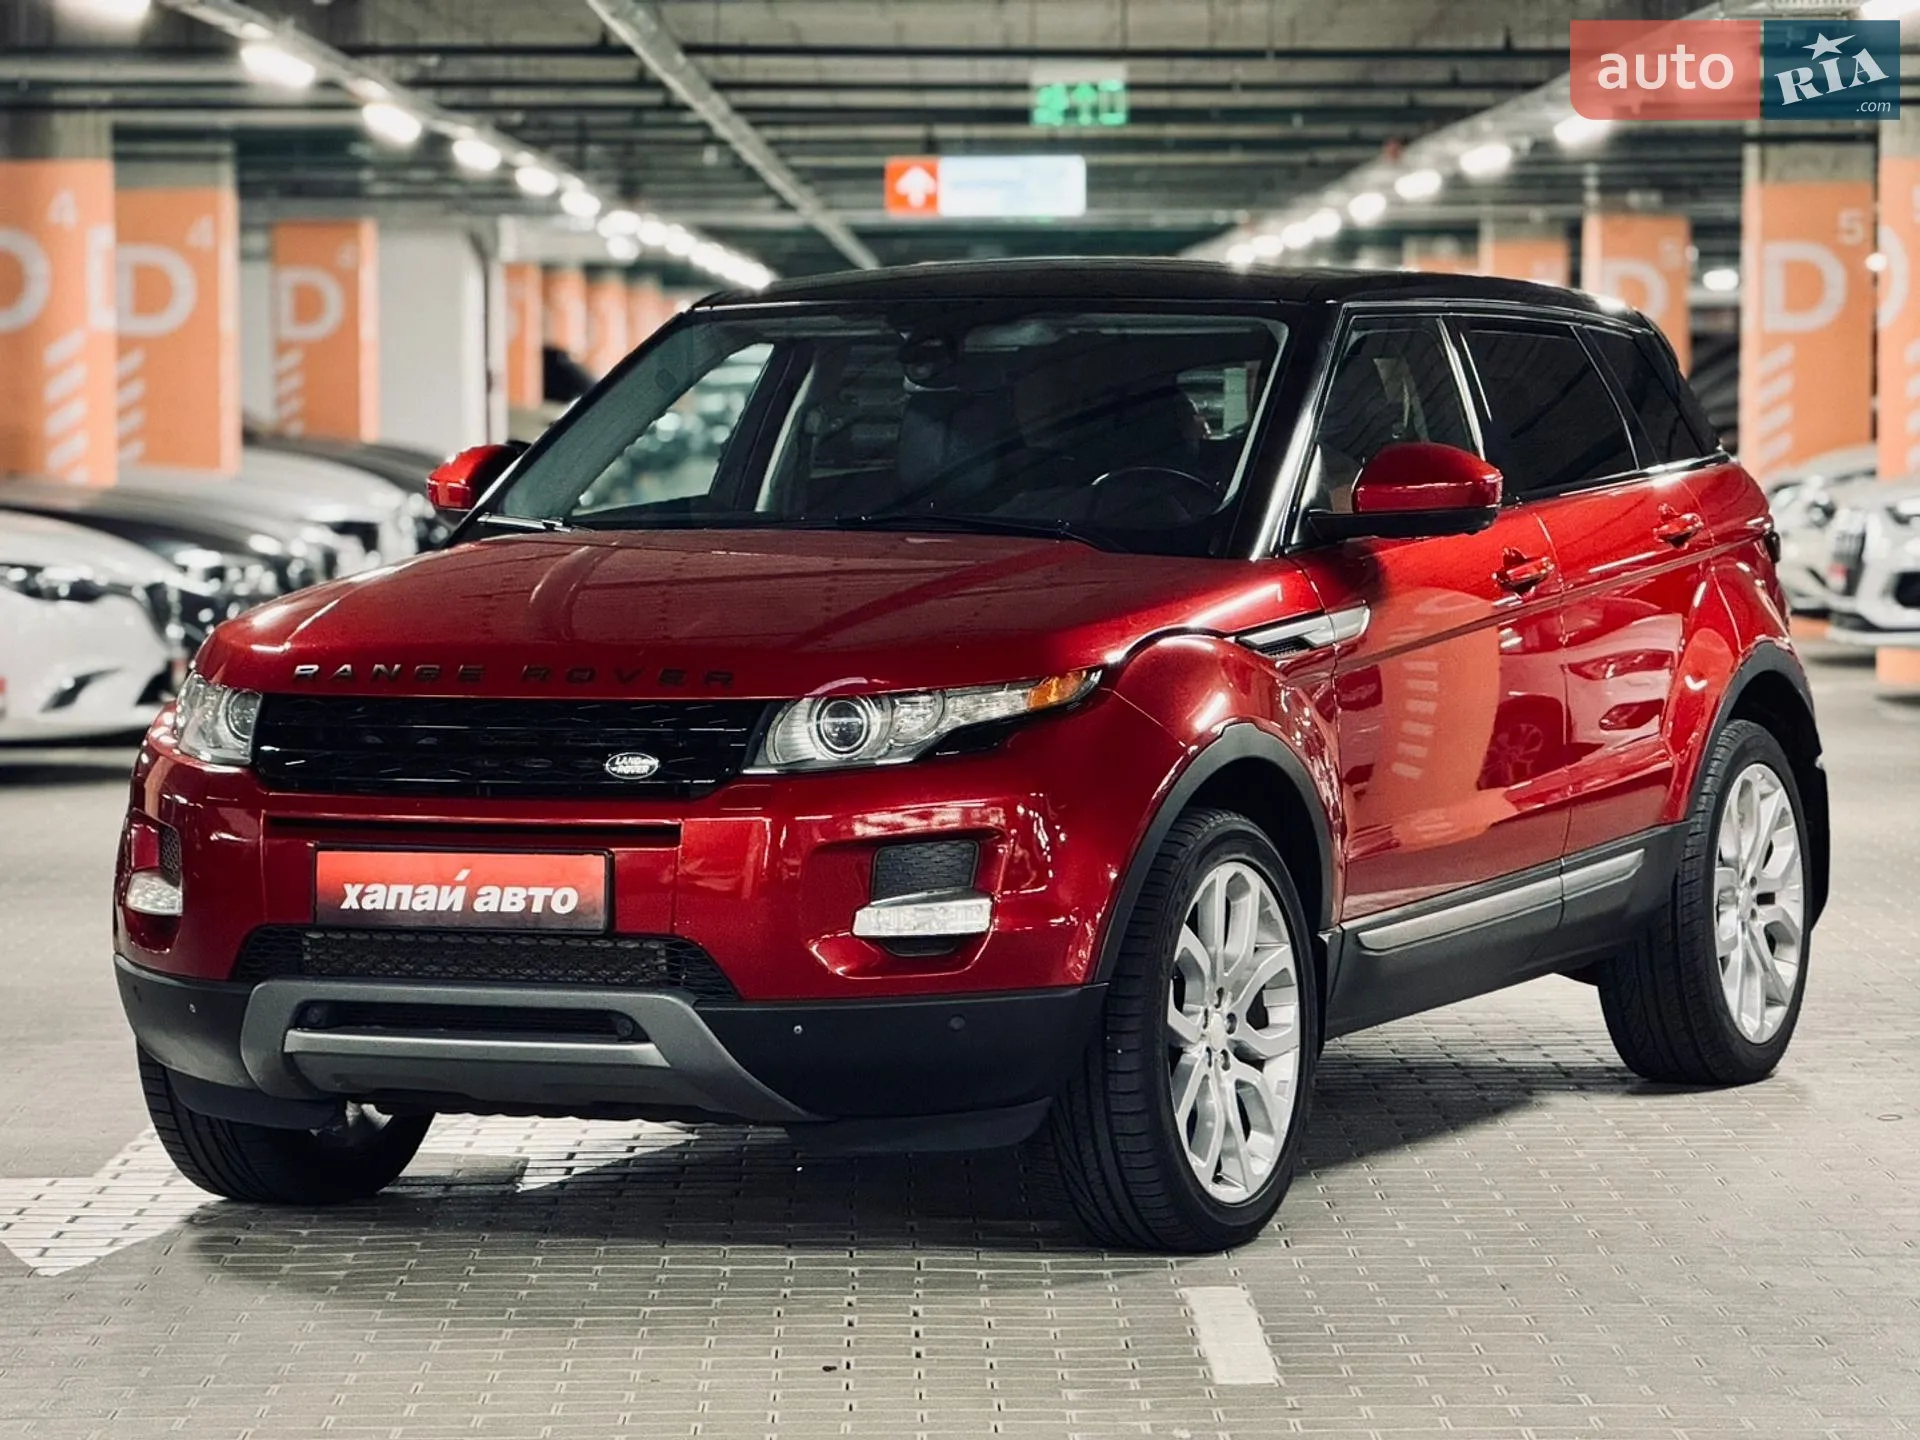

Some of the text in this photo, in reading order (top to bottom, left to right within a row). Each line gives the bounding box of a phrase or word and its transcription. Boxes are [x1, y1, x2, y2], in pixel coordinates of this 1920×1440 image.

[1763, 208, 1864, 333] D 5
[293, 664, 734, 689] RANGE ROVER
[473, 885, 579, 914] авто
